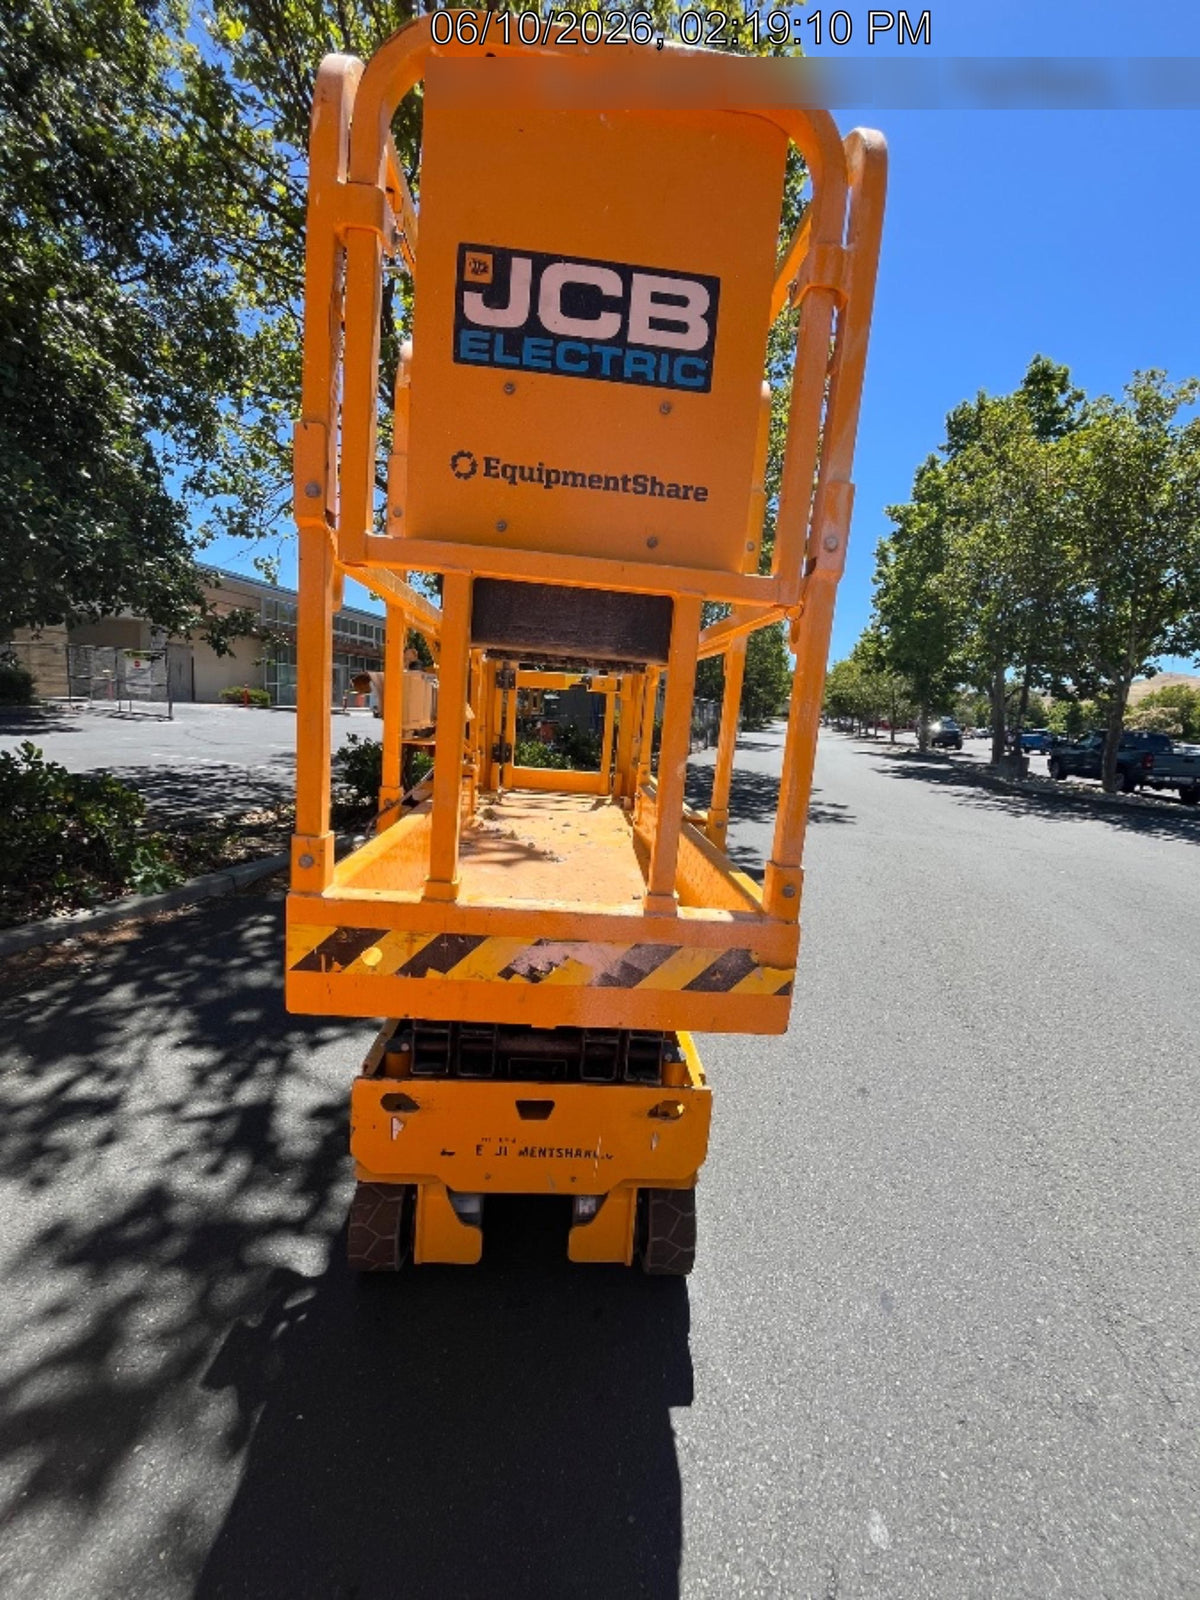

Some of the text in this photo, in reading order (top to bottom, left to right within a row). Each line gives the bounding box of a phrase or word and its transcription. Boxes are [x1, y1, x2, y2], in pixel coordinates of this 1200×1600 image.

[463, 256, 711, 351] JCB
[459, 328, 709, 387] ELECTRIC
[482, 456, 709, 502] EquipmentShare
